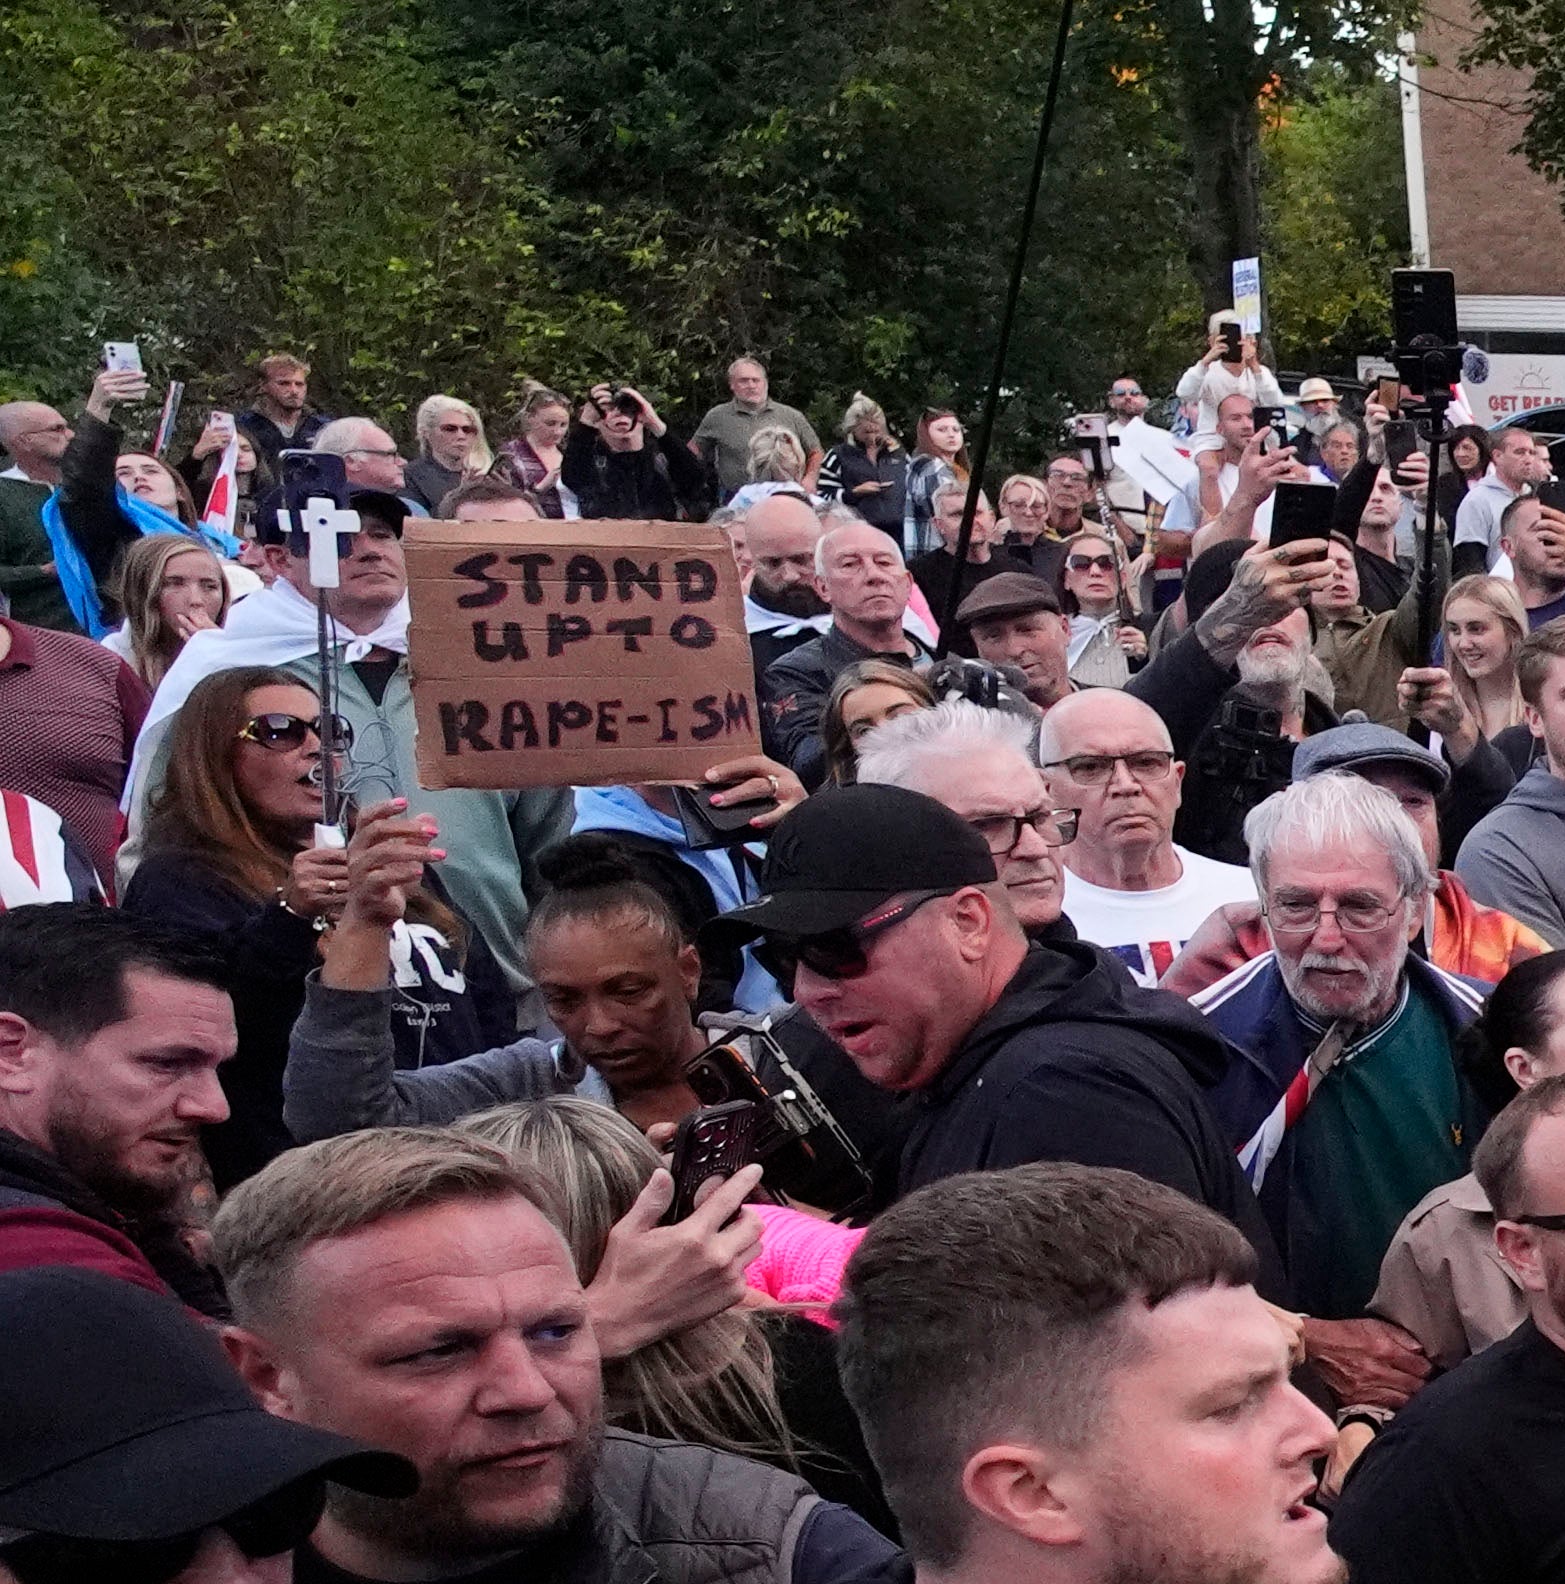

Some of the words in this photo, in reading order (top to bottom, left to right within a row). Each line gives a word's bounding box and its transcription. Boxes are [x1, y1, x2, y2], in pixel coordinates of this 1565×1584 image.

[1488, 395, 1518, 412] GET
[453, 551, 718, 610] STAND
[437, 692, 755, 756] RAPE-ISM
